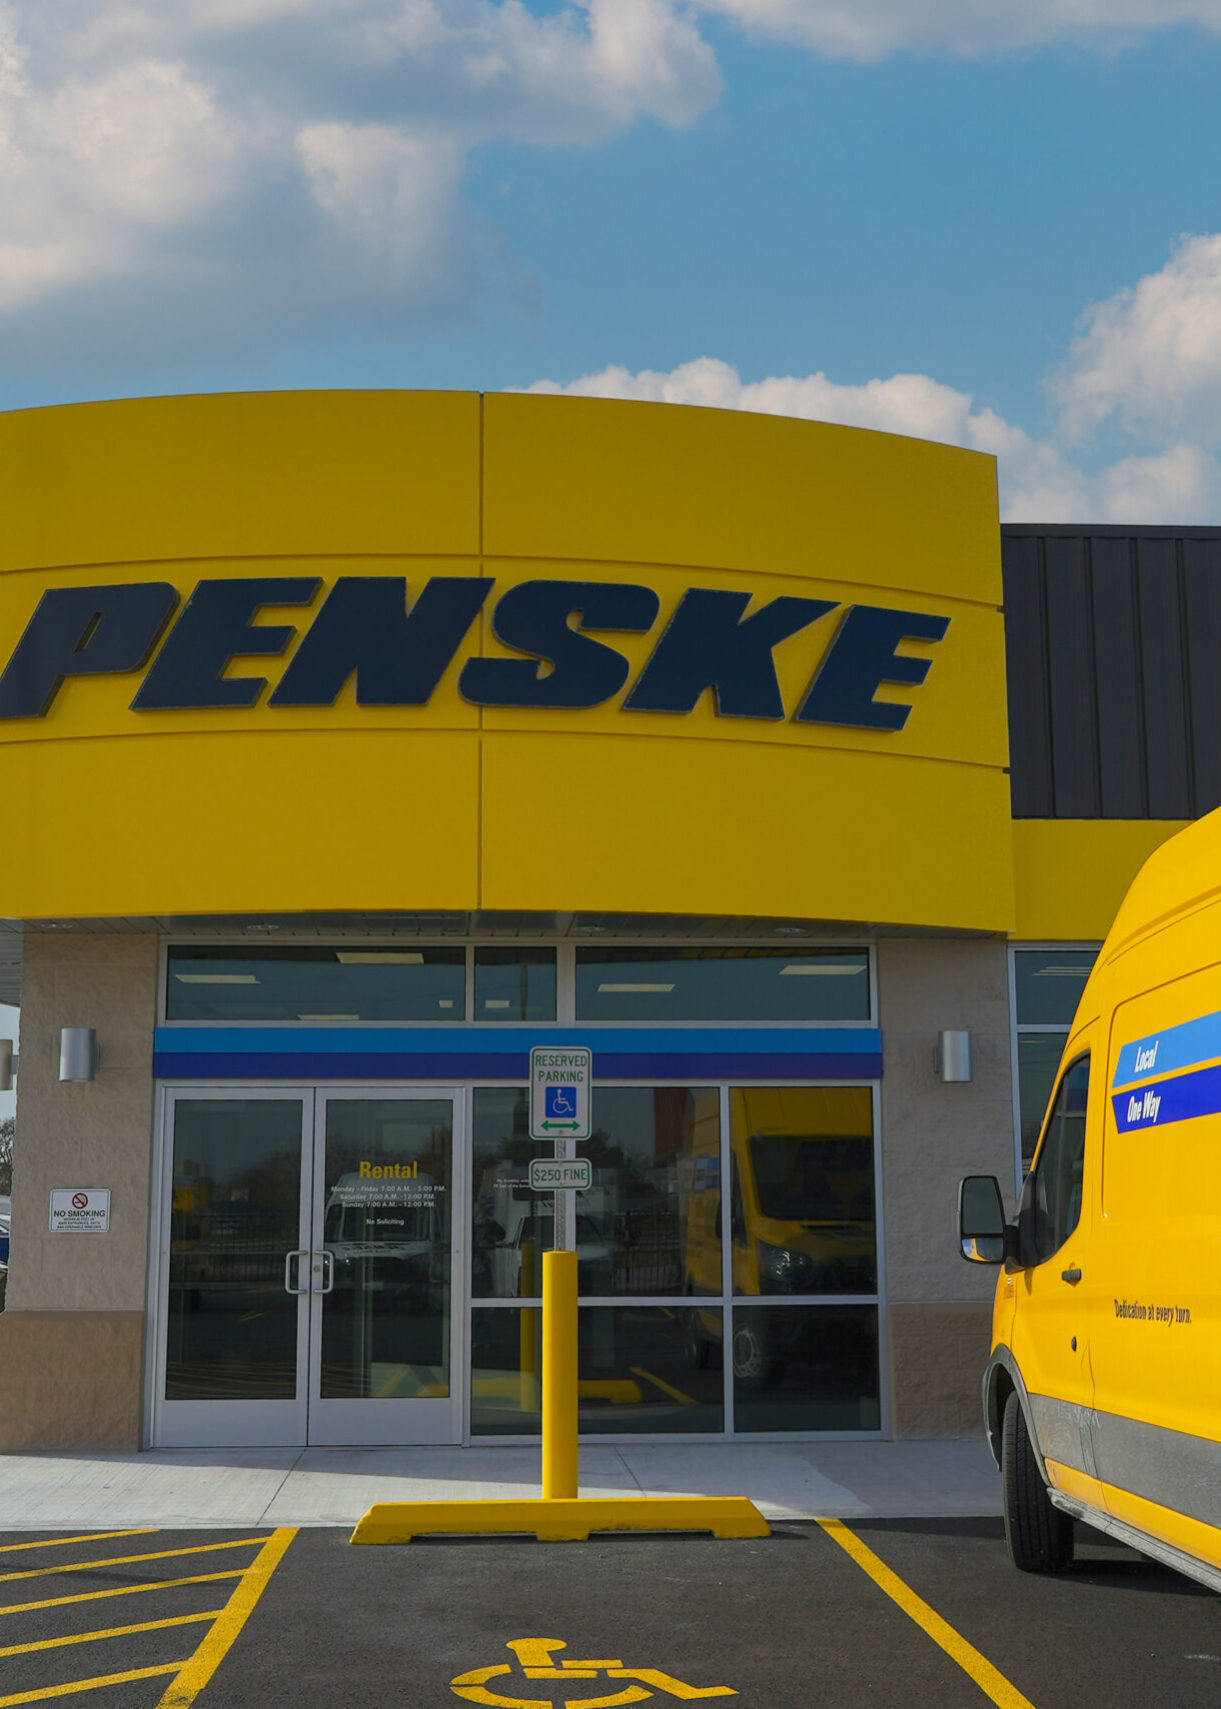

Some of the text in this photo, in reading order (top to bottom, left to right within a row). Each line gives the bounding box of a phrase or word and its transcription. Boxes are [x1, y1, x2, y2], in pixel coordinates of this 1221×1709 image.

[0, 577, 951, 732] PENSKE
[535, 1054, 587, 1067] RESERVED
[1134, 1040, 1159, 1073] Local
[538, 1070, 584, 1082] PARKING
[1127, 1090, 1162, 1123] One Way
[360, 1160, 418, 1179] Rental
[534, 1168, 587, 1182] $250 FINE
[67, 1209, 106, 1217] SMOKING
[376, 1218, 405, 1226] Soliciting
[1114, 1299, 1192, 1327] Dedication at every turn.
